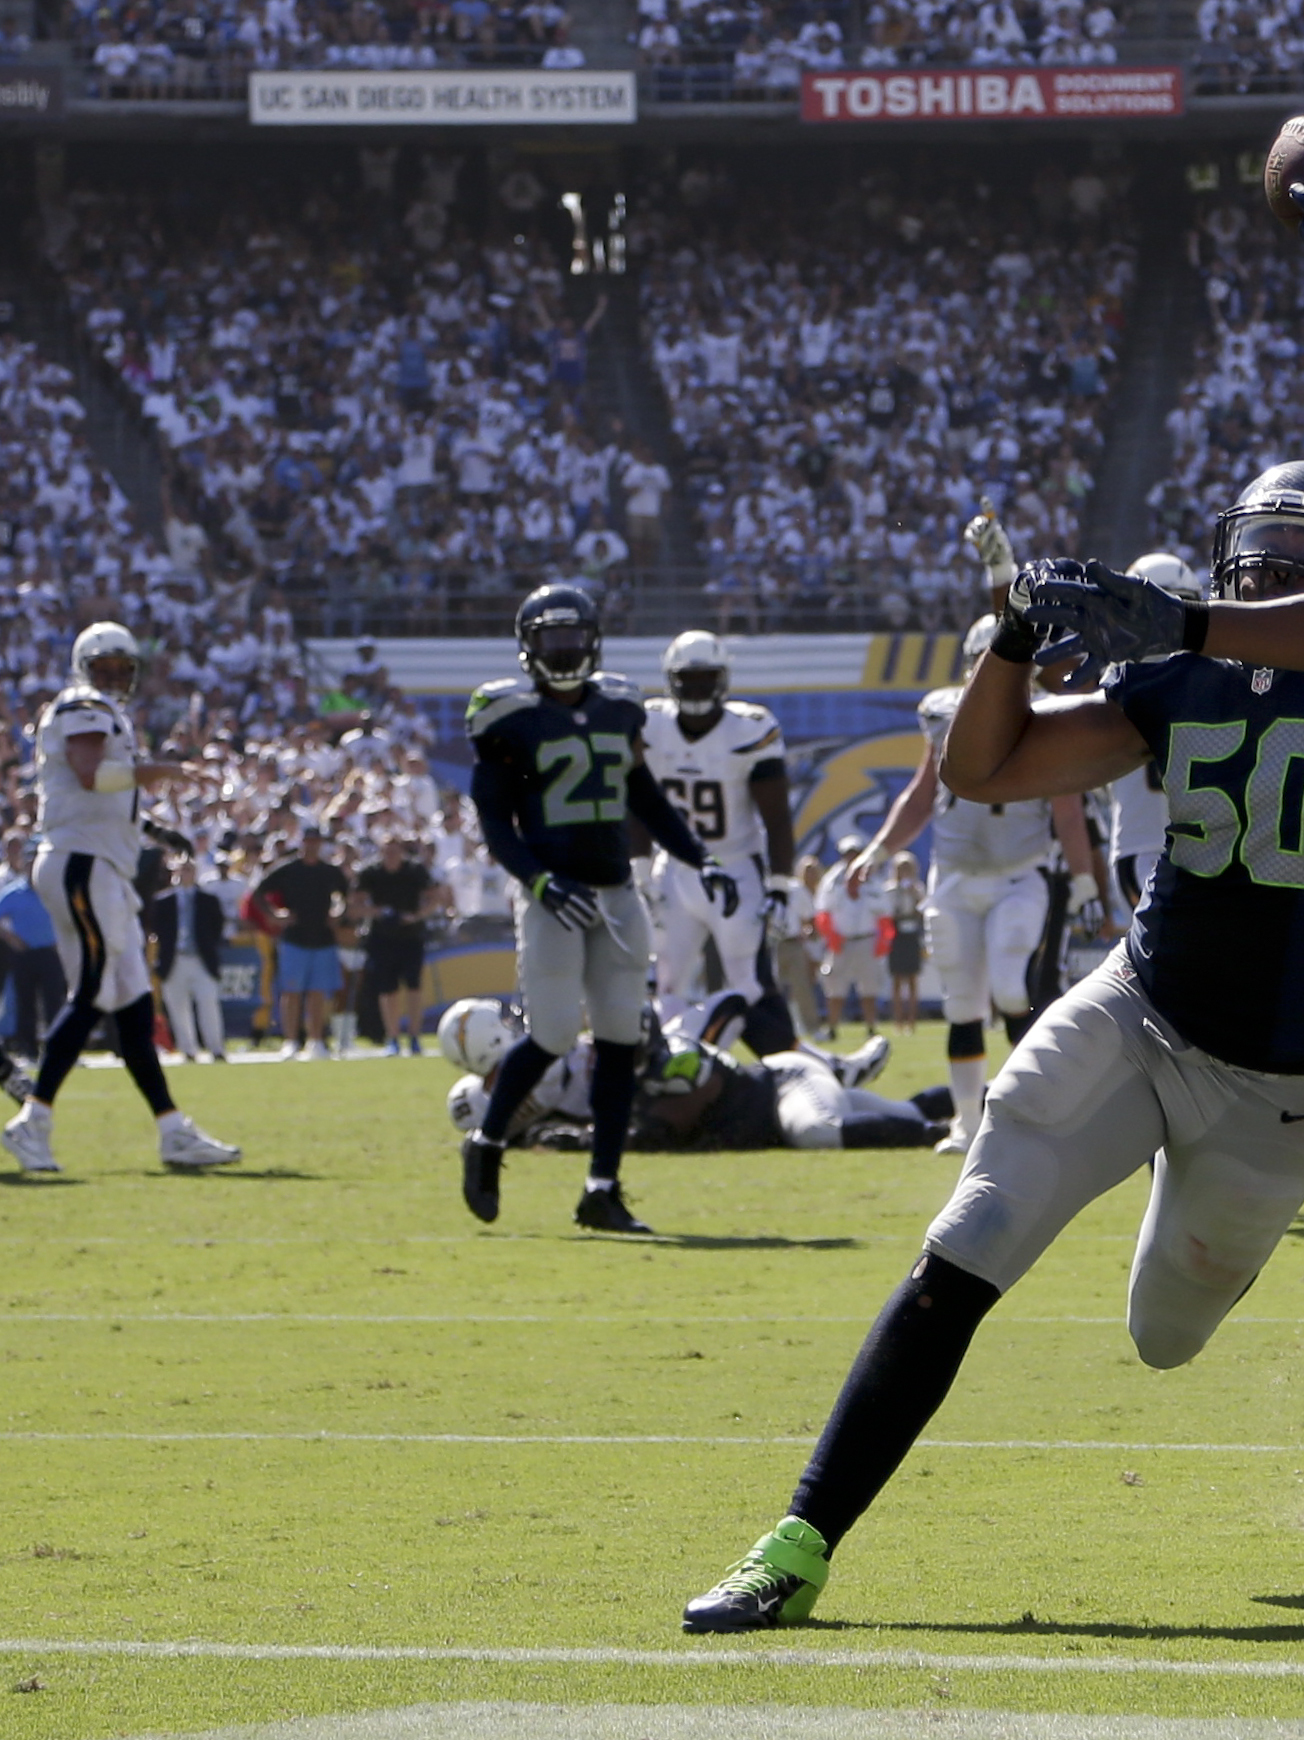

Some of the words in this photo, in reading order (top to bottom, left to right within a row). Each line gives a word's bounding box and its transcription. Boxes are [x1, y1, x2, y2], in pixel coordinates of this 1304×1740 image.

[813, 74, 1046, 116] TOSHIBA
[1054, 73, 1176, 92] DOCUMENT
[258, 85, 293, 110] UC
[301, 85, 349, 110] SAN
[357, 85, 426, 110] DIEGO
[432, 85, 523, 110] HEALTH
[530, 84, 624, 110] SYSTEM
[1054, 93, 1175, 113] SOLUTIONS
[536, 733, 634, 827] 23
